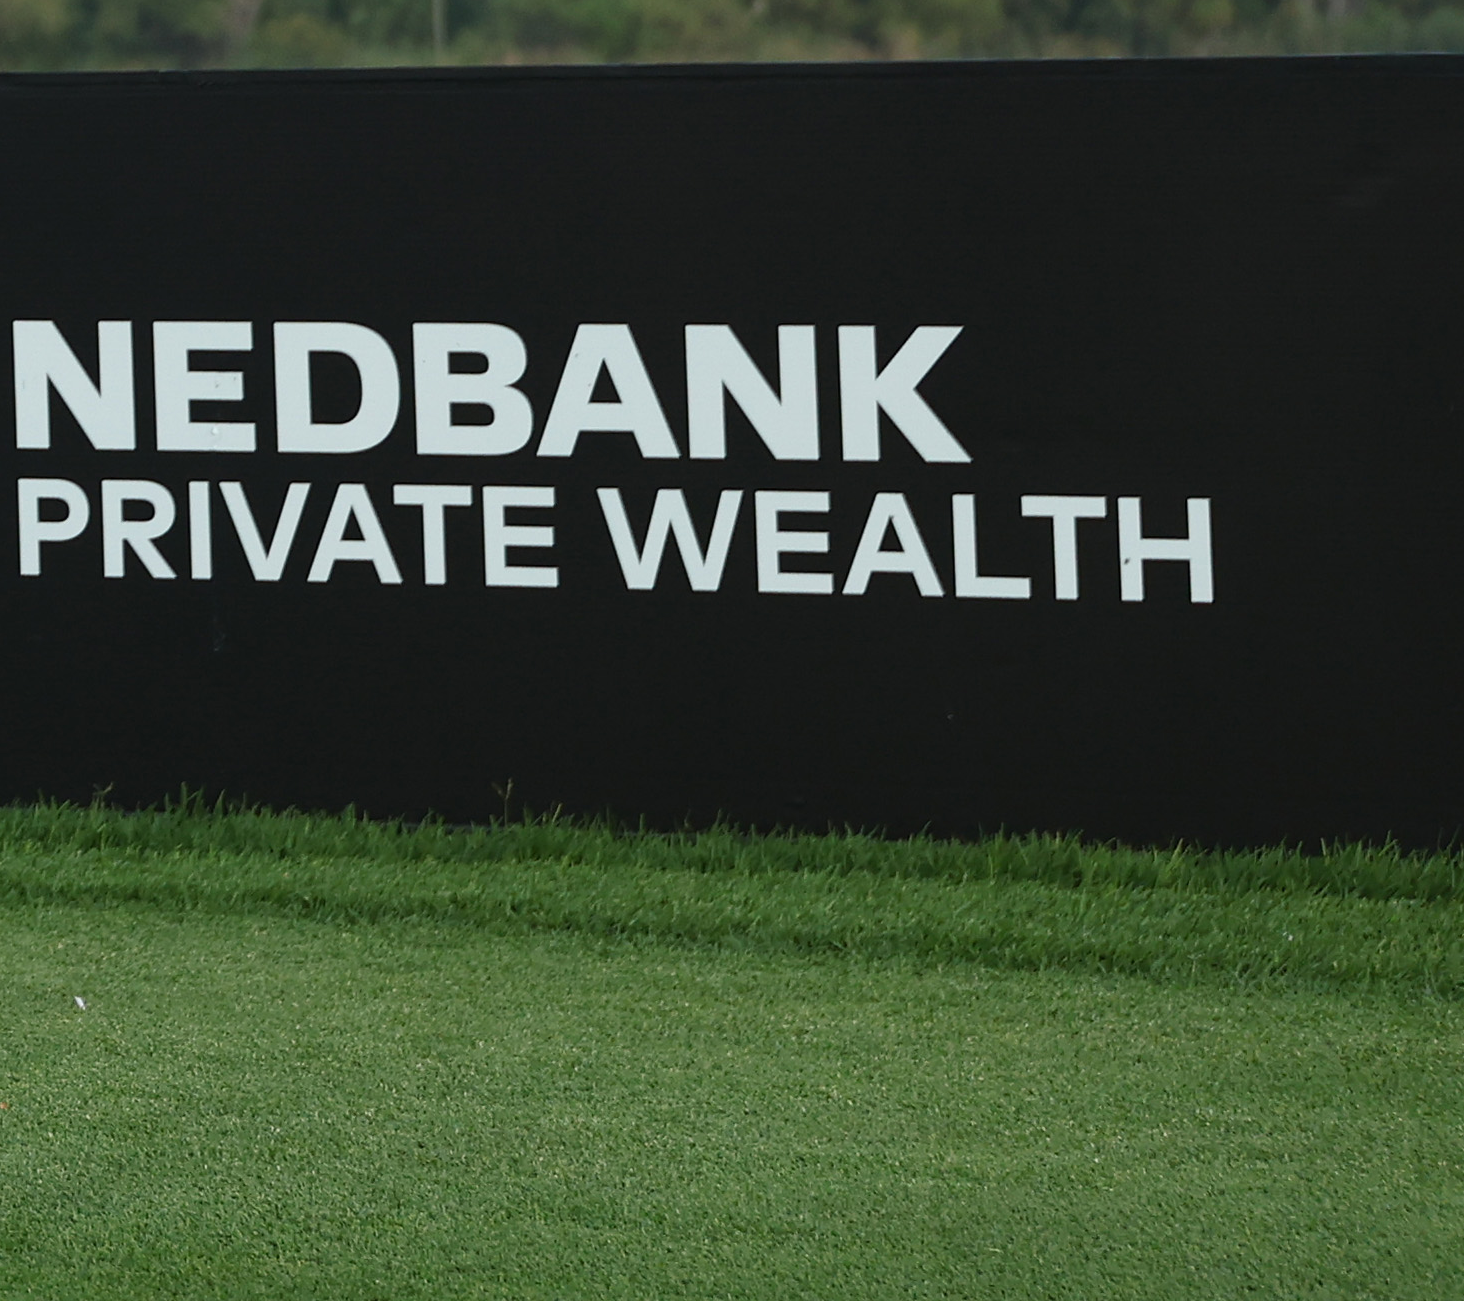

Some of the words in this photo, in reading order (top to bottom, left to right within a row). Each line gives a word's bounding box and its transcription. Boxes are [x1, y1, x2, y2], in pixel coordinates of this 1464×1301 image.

[13, 321, 971, 463] NEDBANK
[18, 479, 558, 587] PRIVATE
[597, 488, 1214, 603] WEALTH
